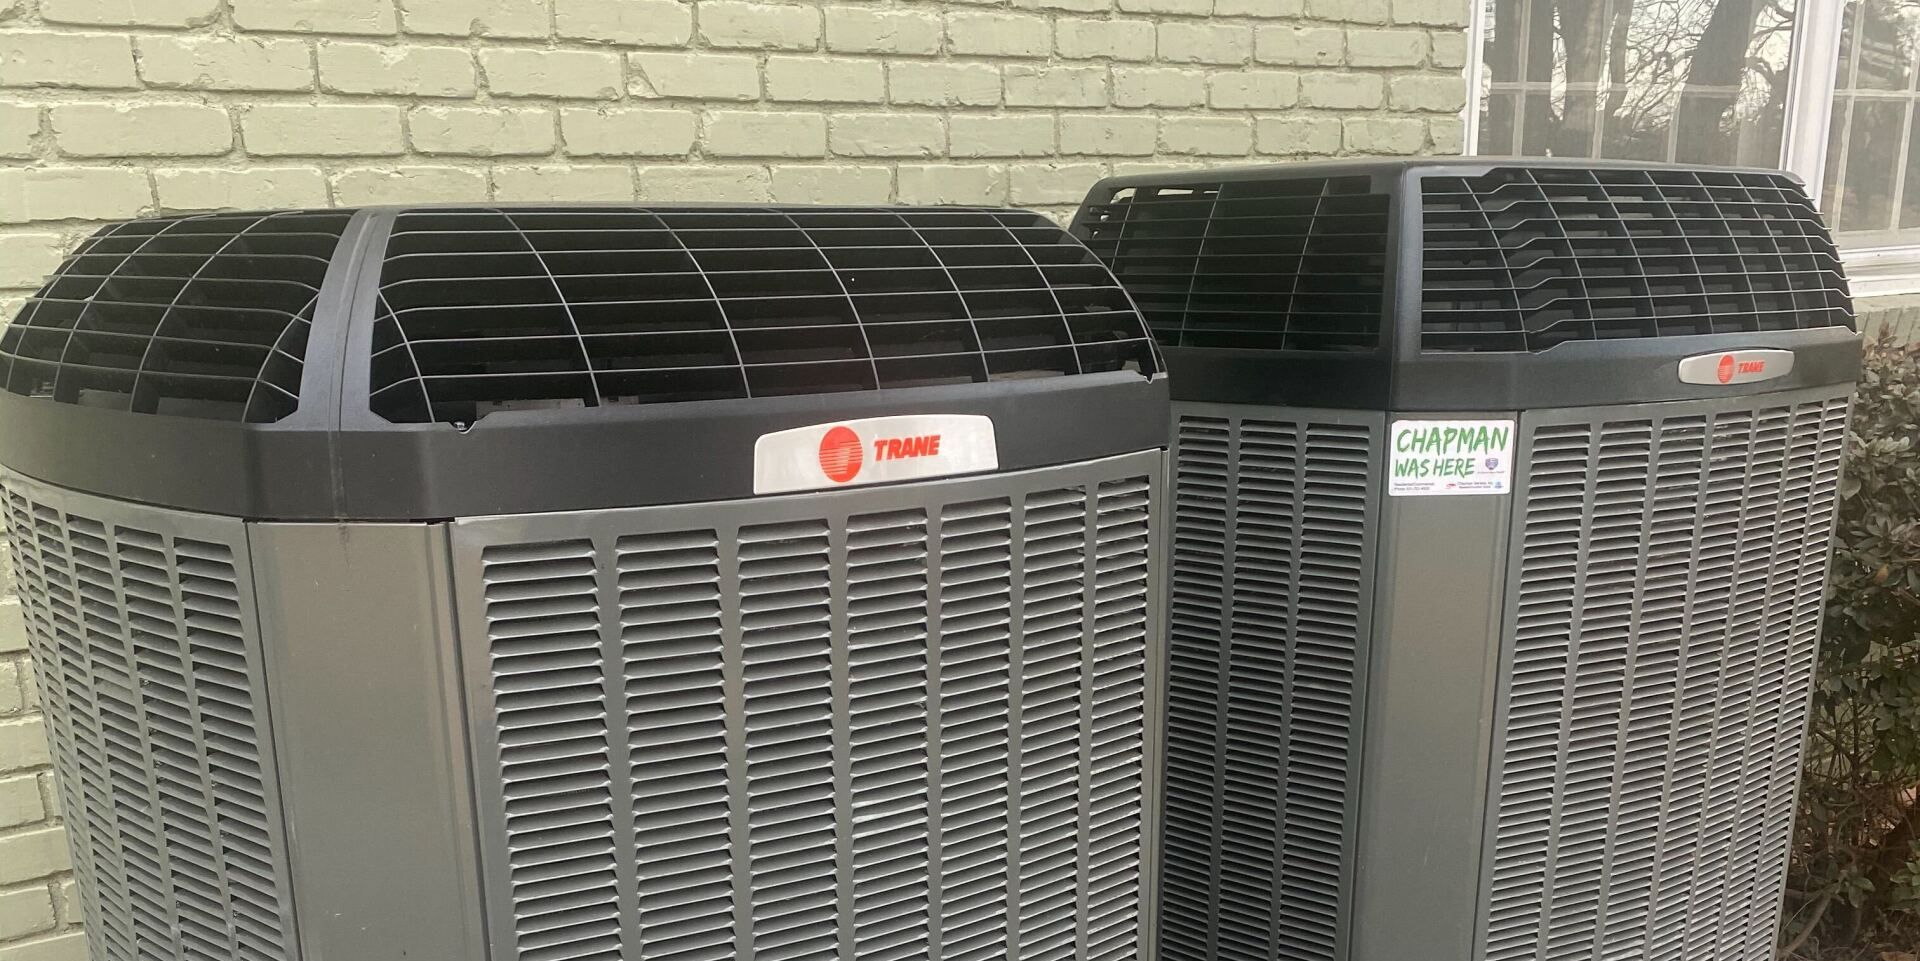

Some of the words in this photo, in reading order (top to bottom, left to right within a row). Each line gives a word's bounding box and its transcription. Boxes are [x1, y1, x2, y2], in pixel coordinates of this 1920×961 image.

[1738, 361, 1765, 373] TRANE
[874, 435, 940, 461] TRANE
[1397, 426, 1508, 456] CHAPMAN
[1395, 458, 1430, 479] WAS
[1433, 458, 1475, 478] HERE
